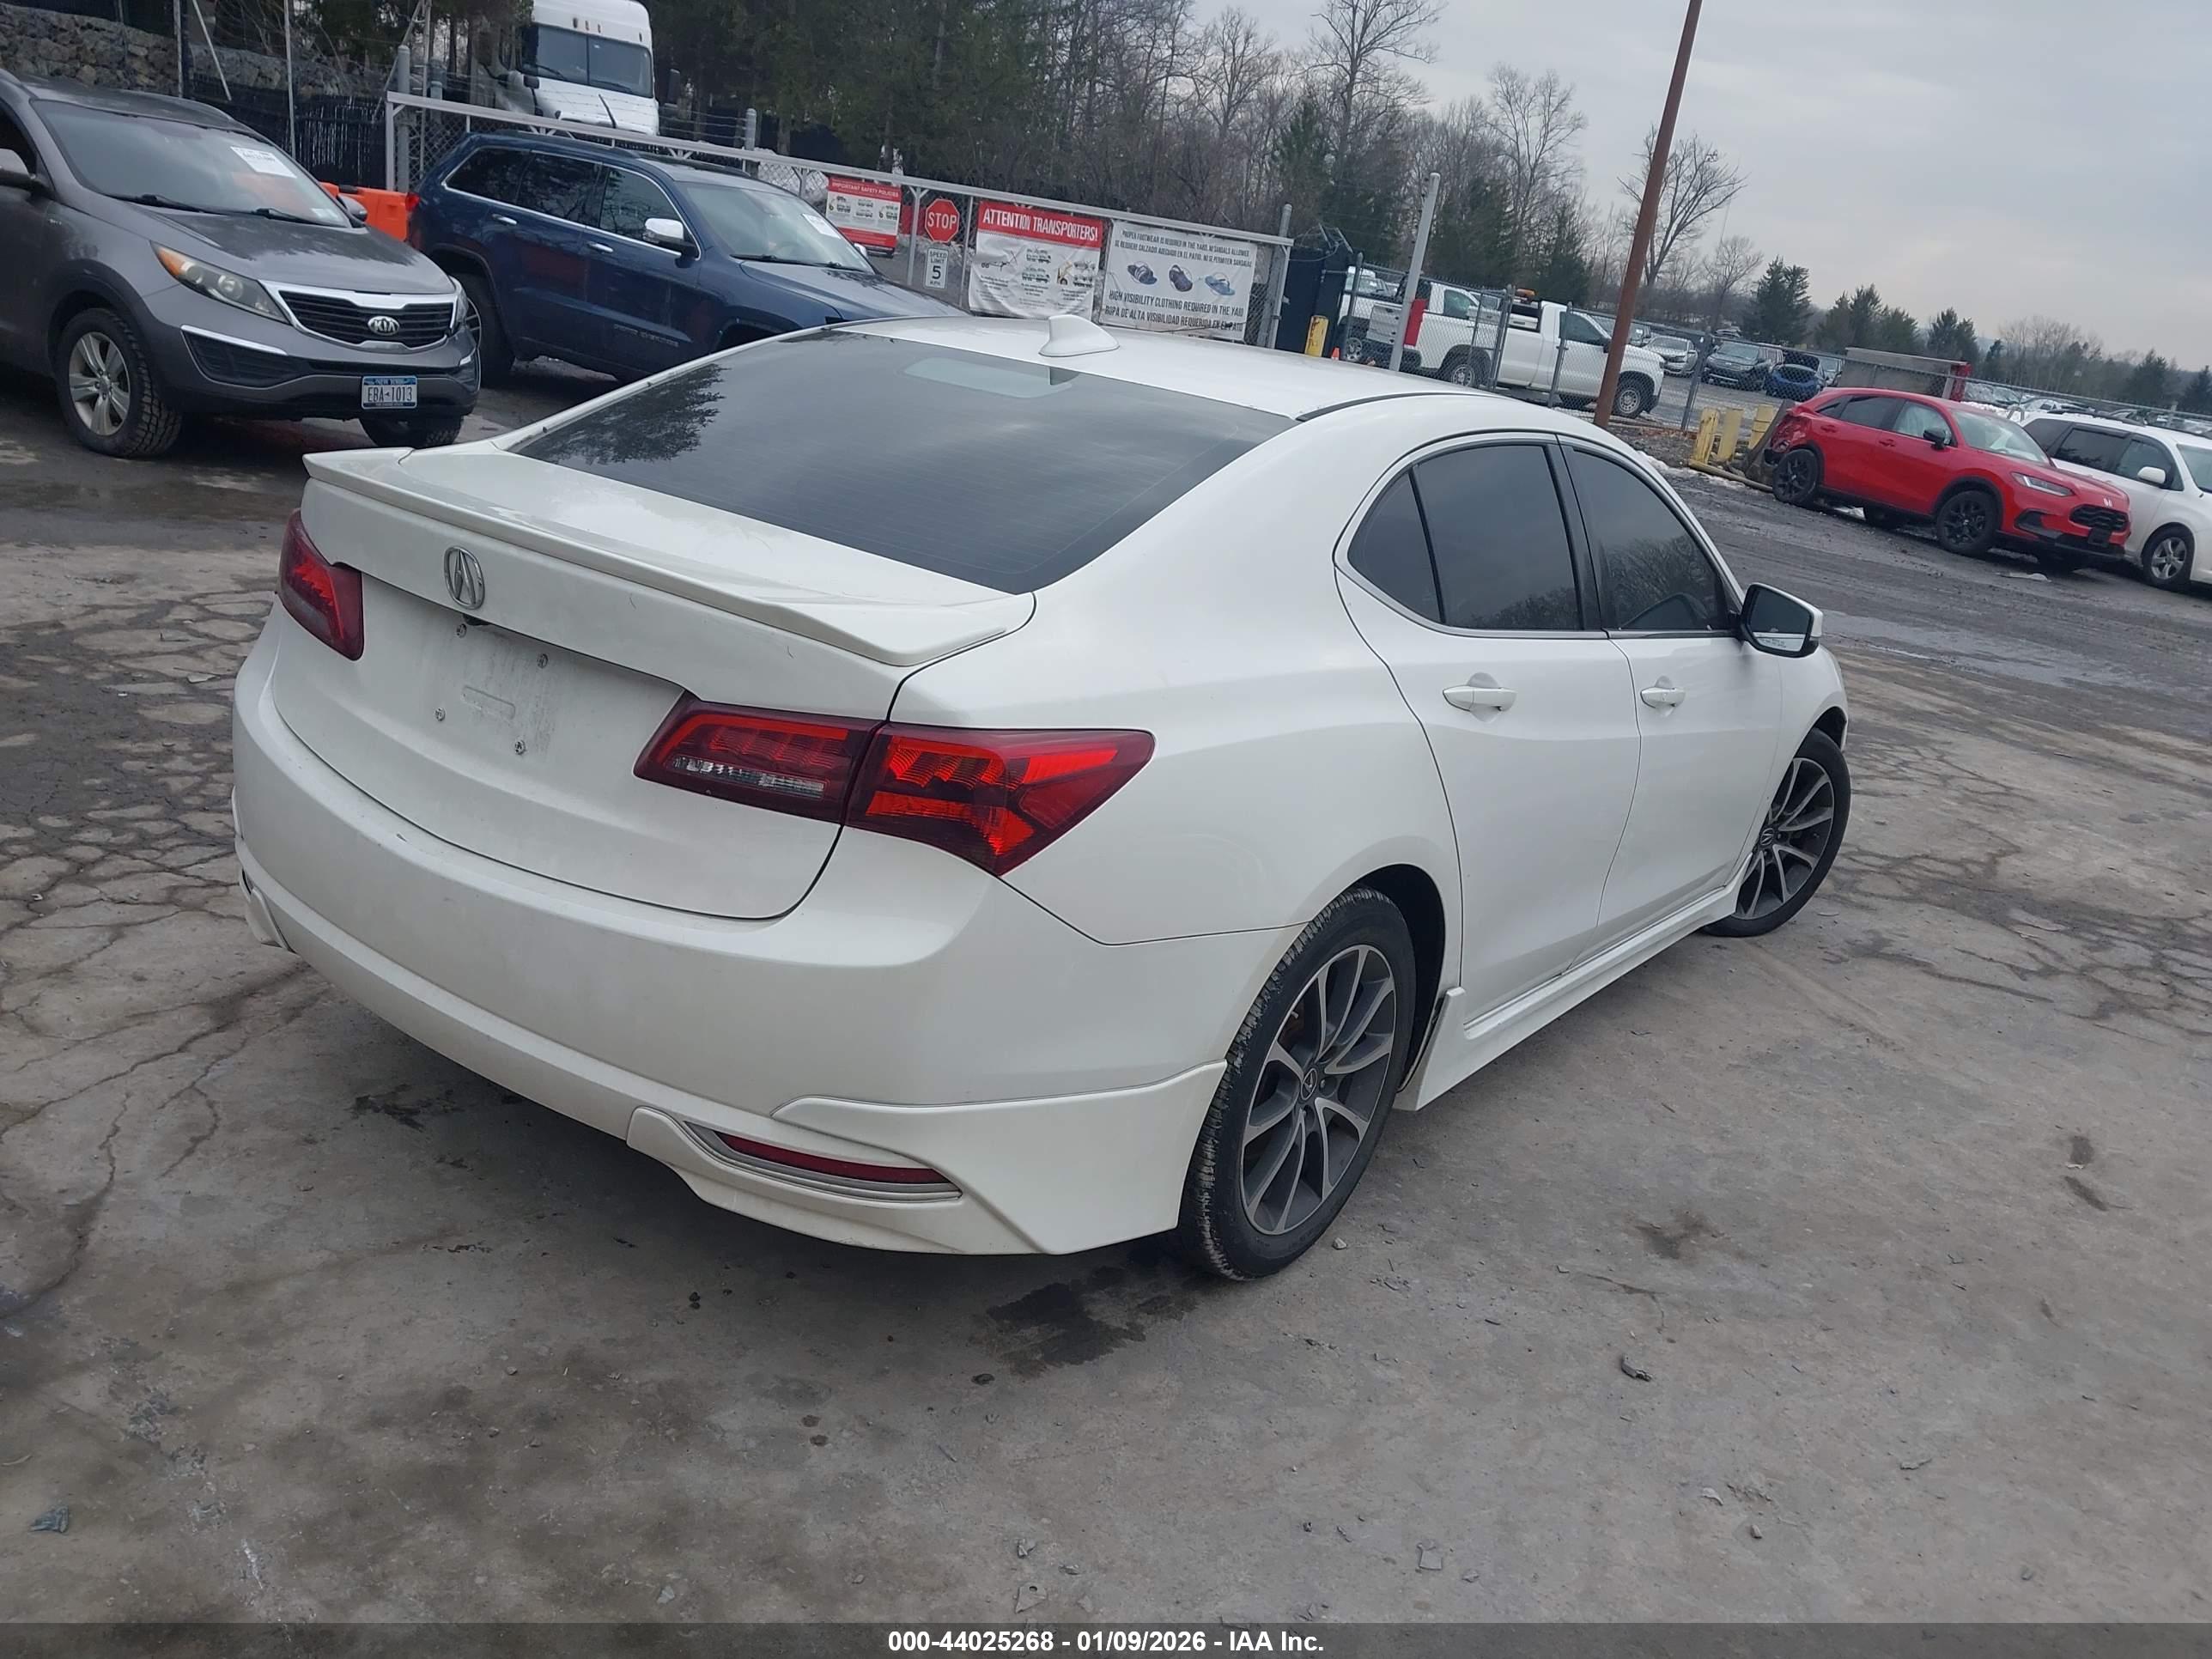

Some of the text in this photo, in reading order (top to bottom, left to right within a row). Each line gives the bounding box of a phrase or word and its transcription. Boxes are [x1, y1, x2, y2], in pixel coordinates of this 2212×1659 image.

[927, 211, 957, 229] STOP
[982, 209, 1098, 241] ATTENTION TRANSPORTERS!
[932, 265, 941, 279] 5
[1109, 289, 1122, 301] HIGH
[1124, 293, 1155, 306] VISIBILITY
[1155, 297, 1182, 310] CLOTHING
[1183, 301, 1211, 313] REQUIRED
[1212, 304, 1218, 314] IN
[1219, 305, 1230, 316] THE
[1121, 308, 1128, 318] DE
[1129, 309, 1145, 321] ALTA
[1146, 312, 1179, 325] VISIBILIDAD
